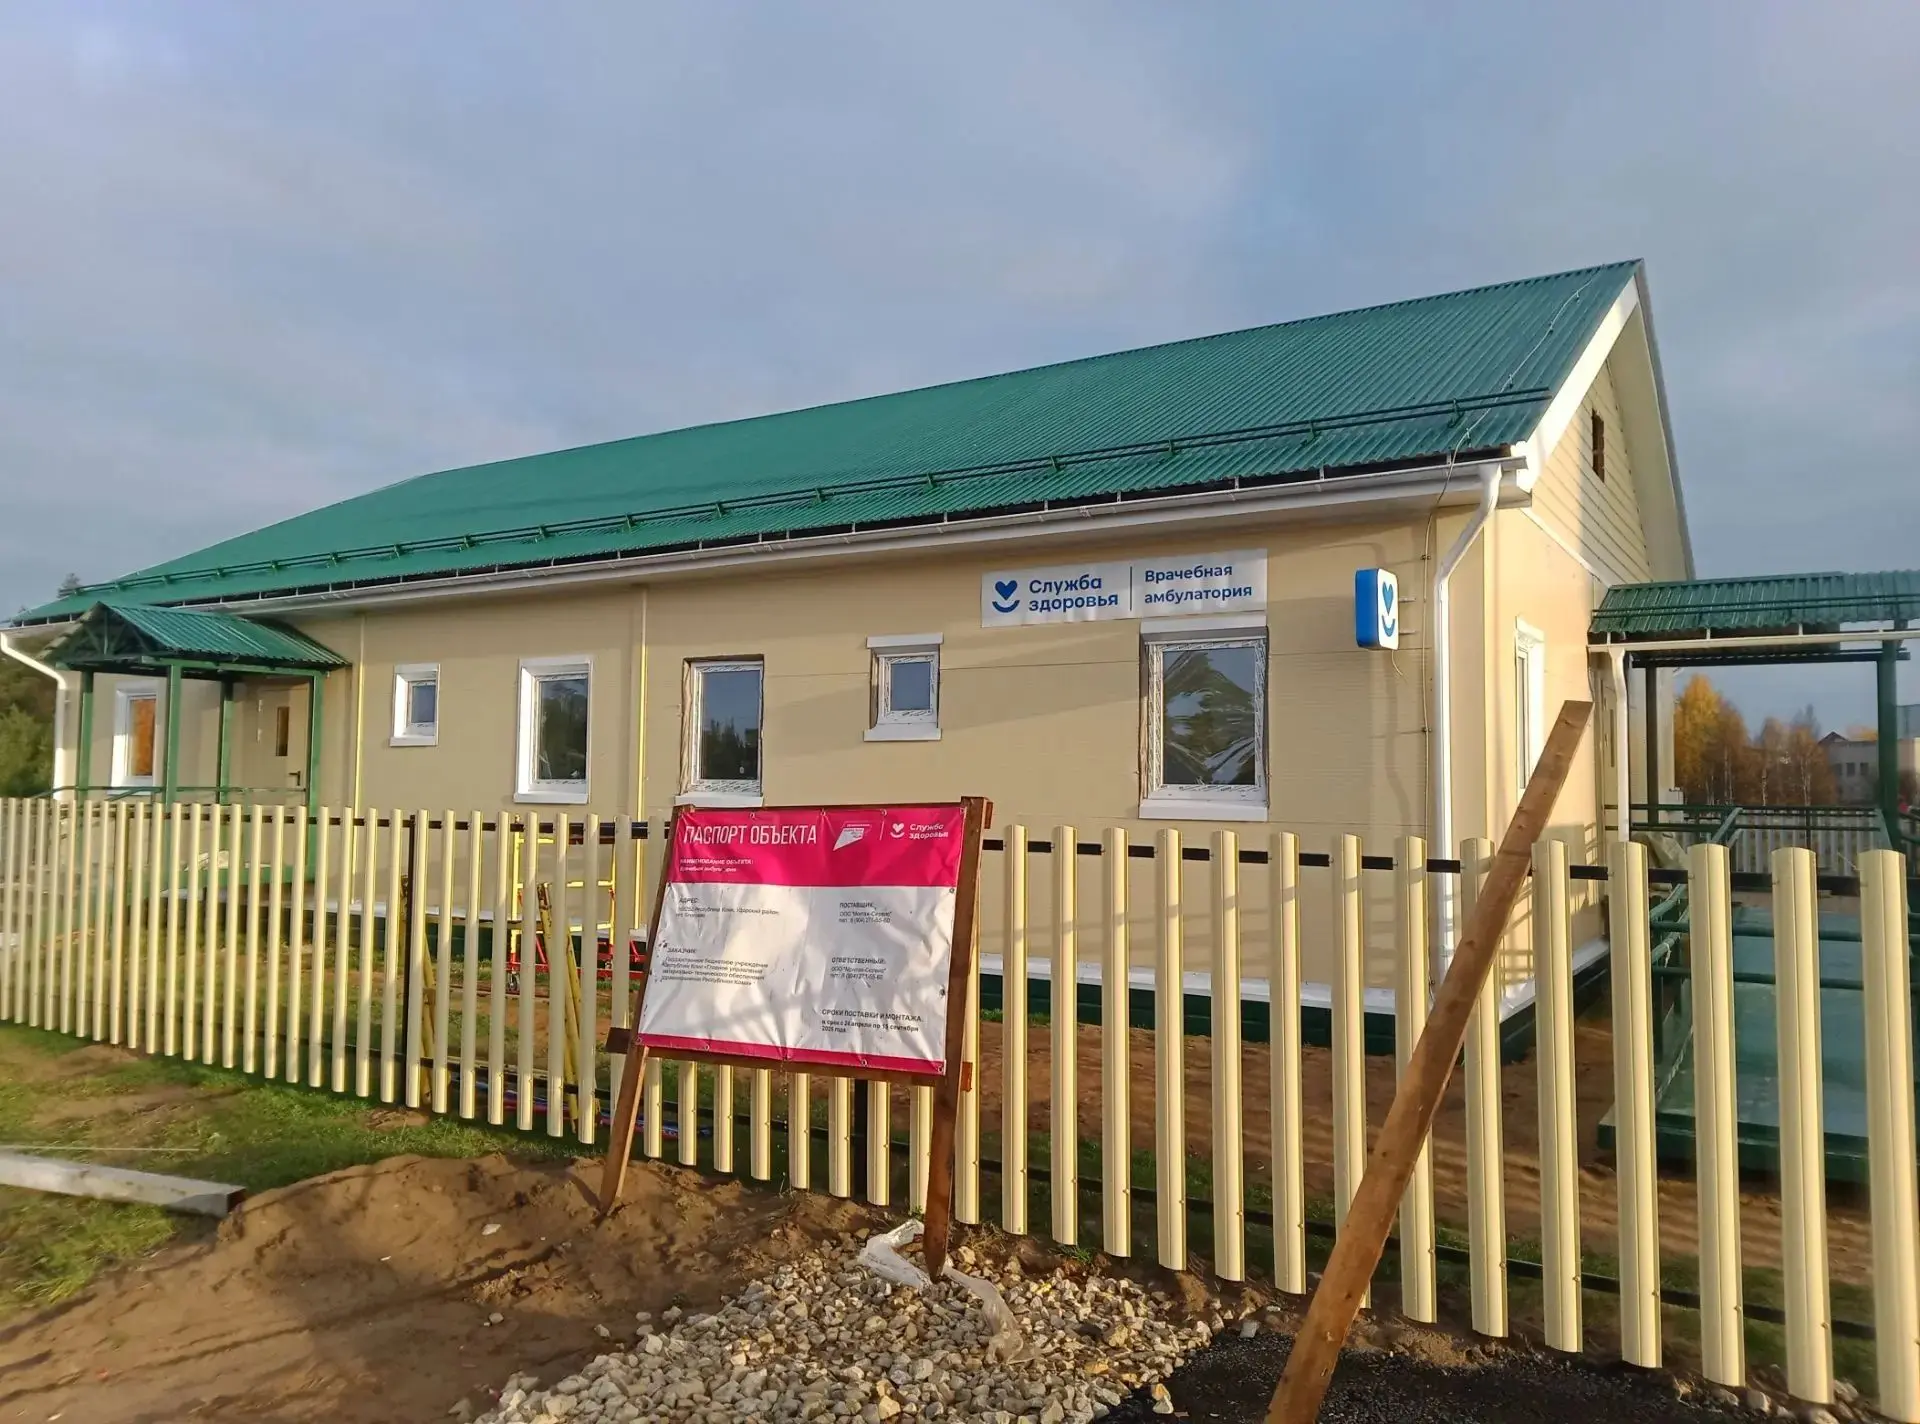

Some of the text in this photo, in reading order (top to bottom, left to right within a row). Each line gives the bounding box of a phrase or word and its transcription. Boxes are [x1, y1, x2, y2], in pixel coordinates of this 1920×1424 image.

[1144, 564, 1233, 584] Врачебная
[1029, 575, 1102, 596] Служба
[1144, 584, 1252, 604] амбулатория
[1029, 594, 1119, 613] здоровья
[683, 824, 817, 845] ПАСПОРТ ОБЪЕКТА
[909, 822, 945, 832] Служба
[909, 831, 949, 840] здоровья
[844, 1010, 878, 1019] ПОСТАВКИ
